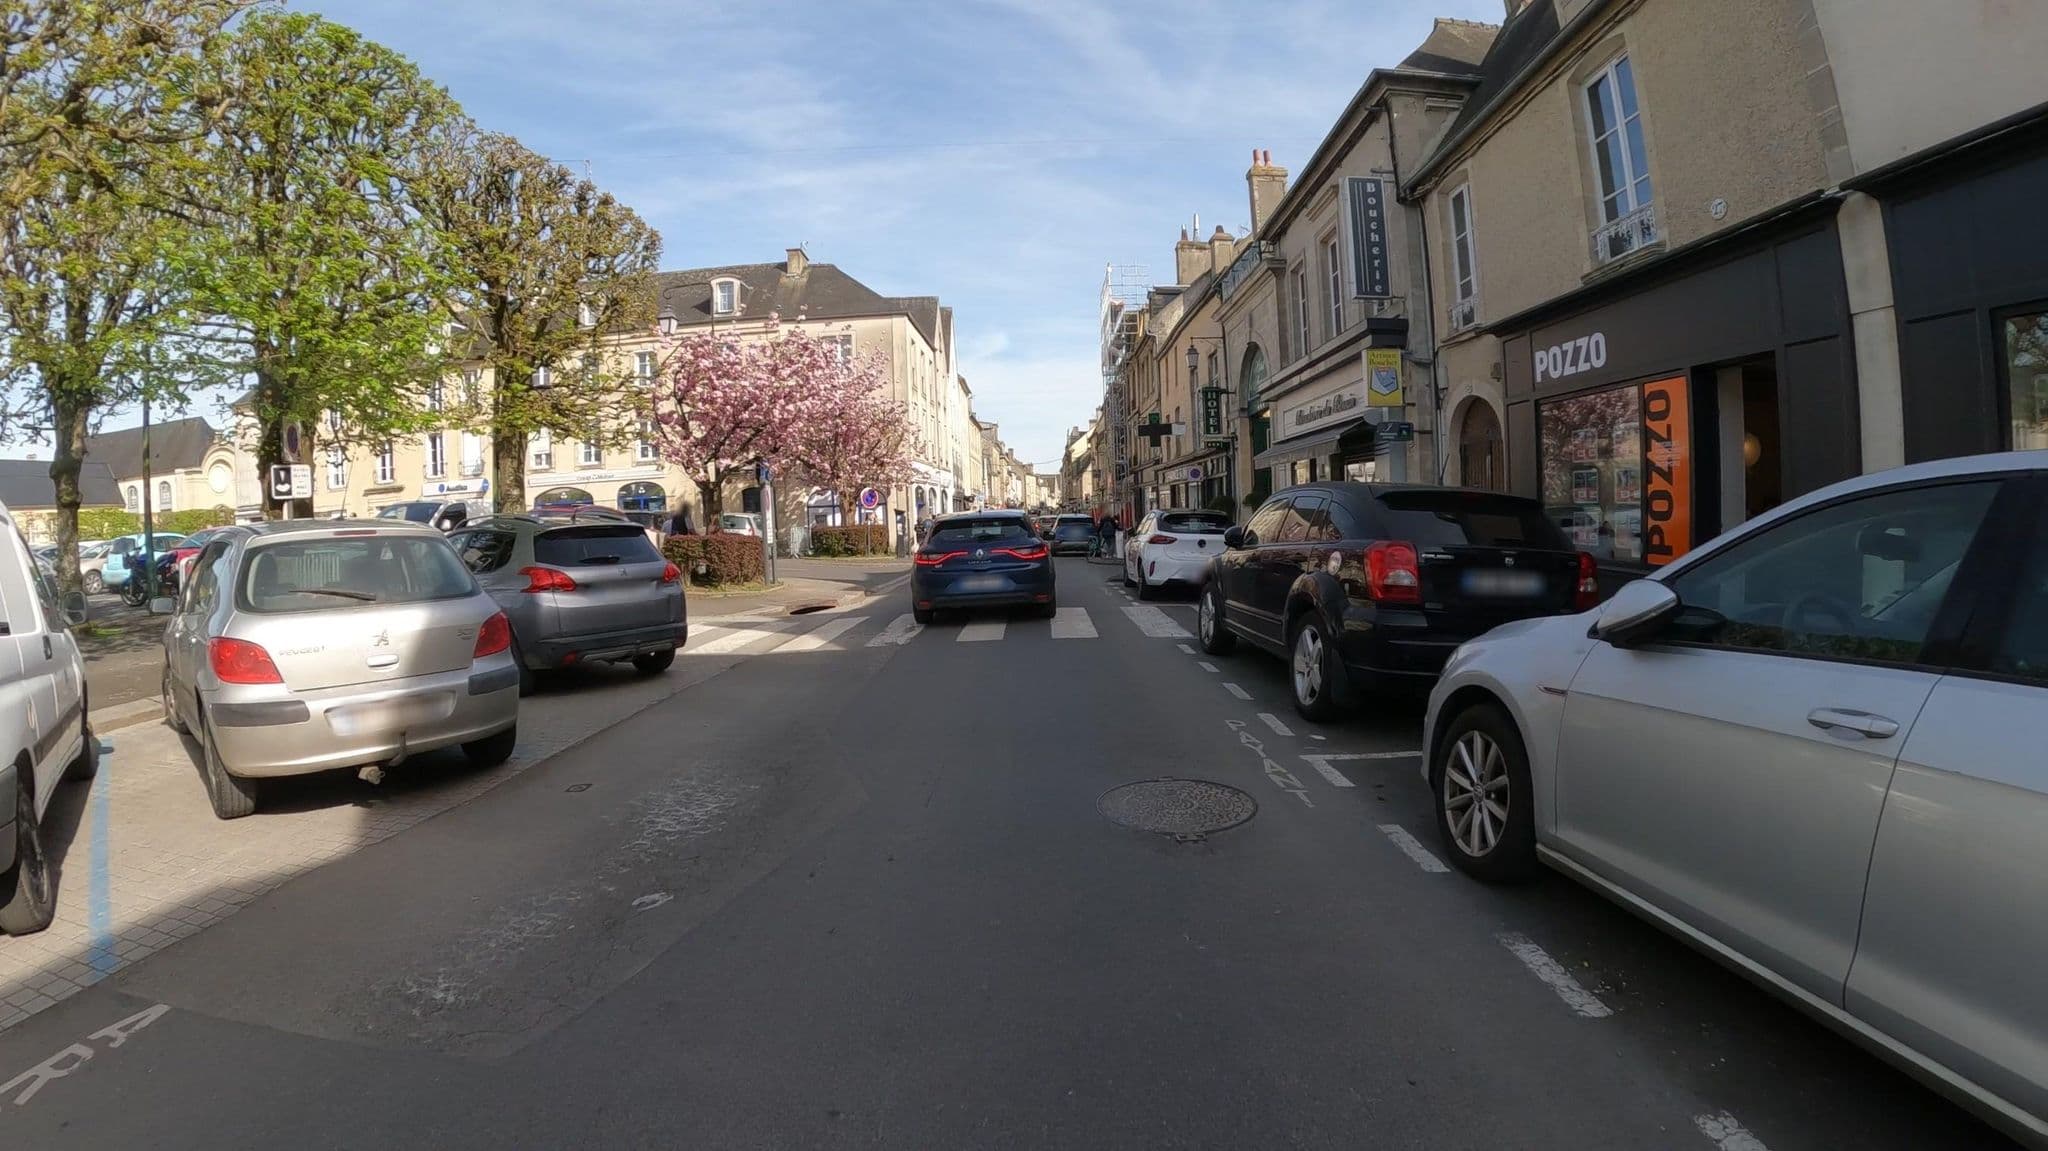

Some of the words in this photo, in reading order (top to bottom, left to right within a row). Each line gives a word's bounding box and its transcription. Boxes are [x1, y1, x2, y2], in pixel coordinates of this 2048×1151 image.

[1366, 182, 1383, 293] Boucherie
[1535, 332, 1607, 383] POZZO
[1207, 391, 1219, 434] HOTEL
[1647, 388, 1674, 557] POZZO
[1225, 719, 1316, 808] PAYANT
